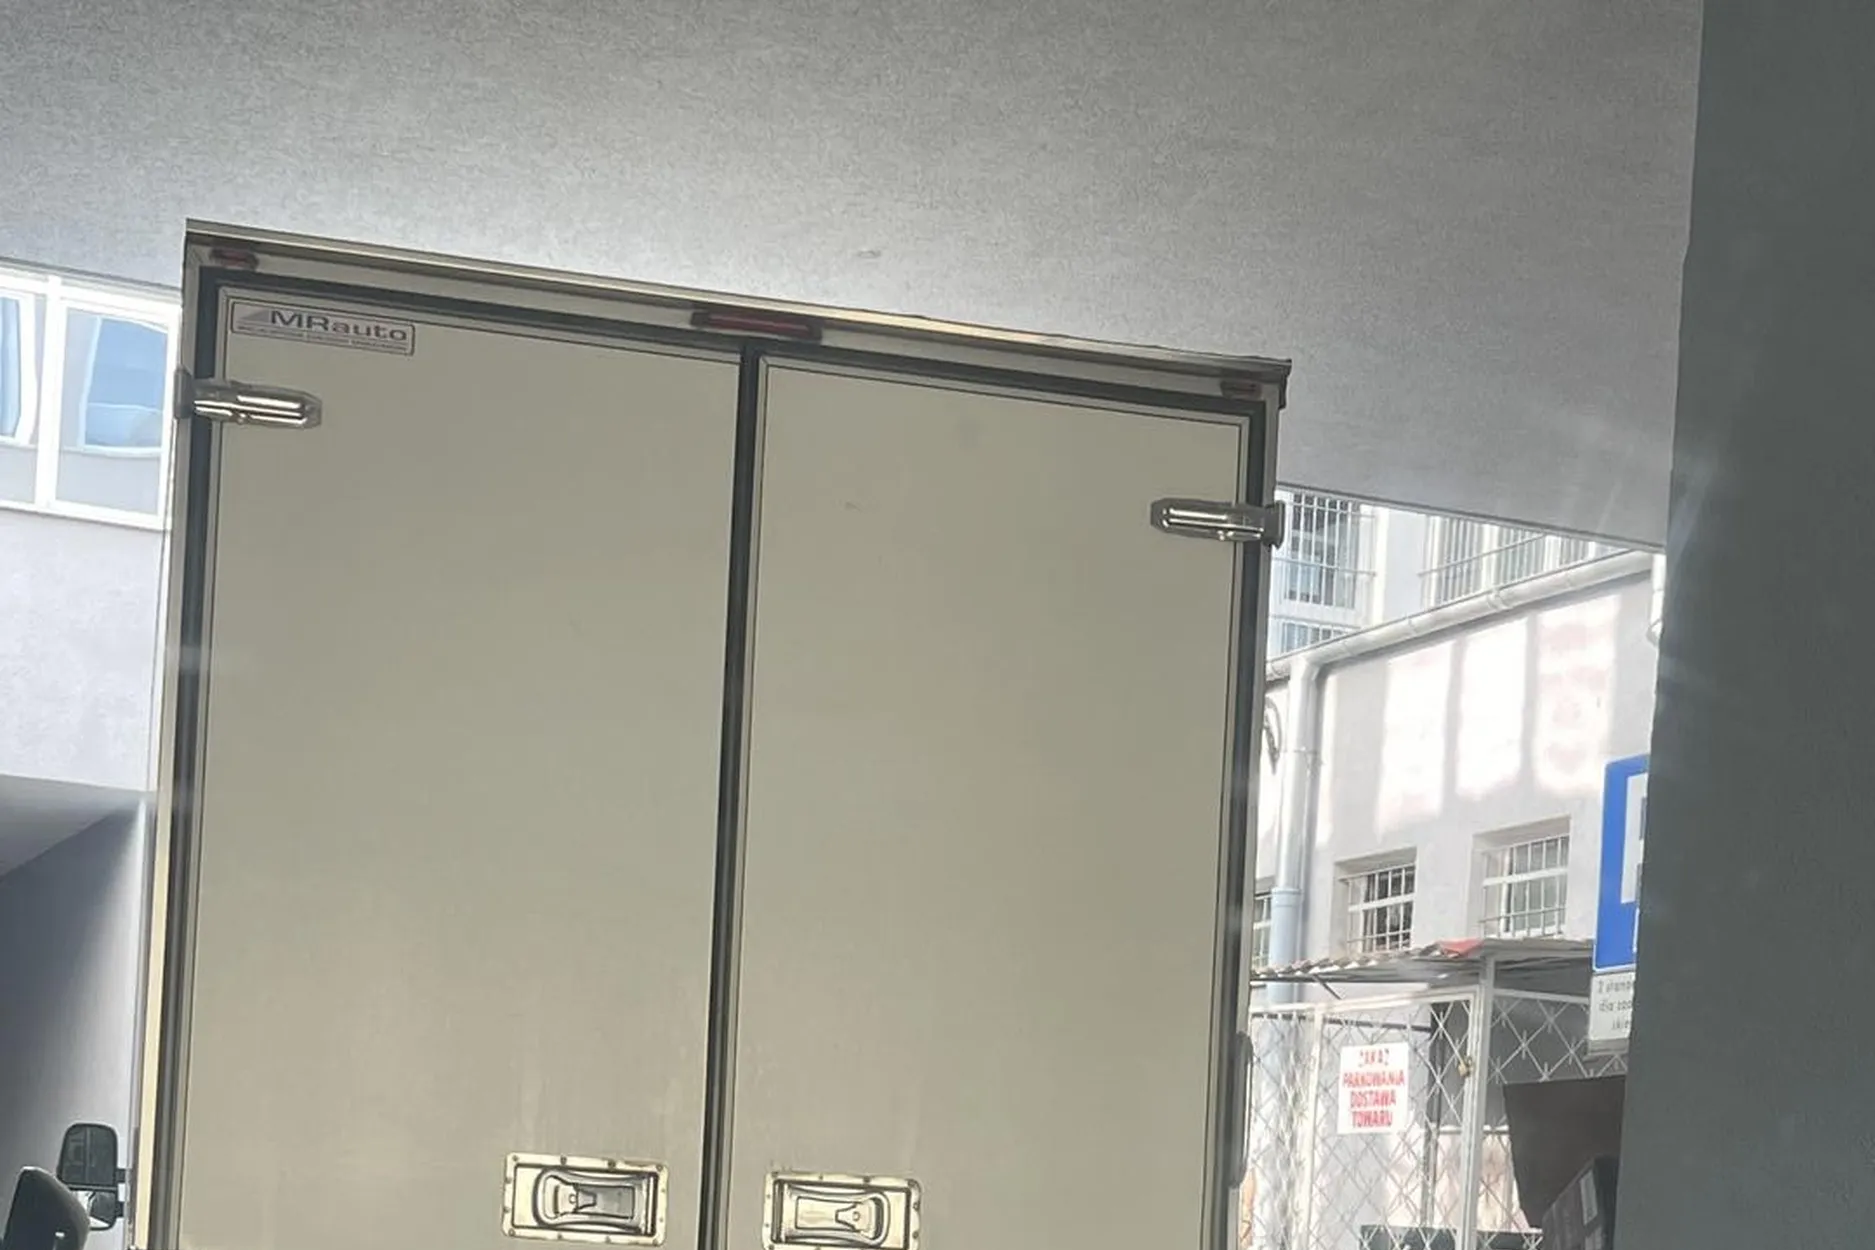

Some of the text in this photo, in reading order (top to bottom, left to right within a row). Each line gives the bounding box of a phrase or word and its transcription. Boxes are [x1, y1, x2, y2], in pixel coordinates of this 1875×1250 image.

[271, 309, 408, 342] MRauto
[1358, 1047, 1390, 1068] ZAKAZ
[1342, 1069, 1405, 1089] PARKOWANIA
[1350, 1089, 1397, 1109] DOSTAWA
[1351, 1109, 1393, 1128] TOWARU
